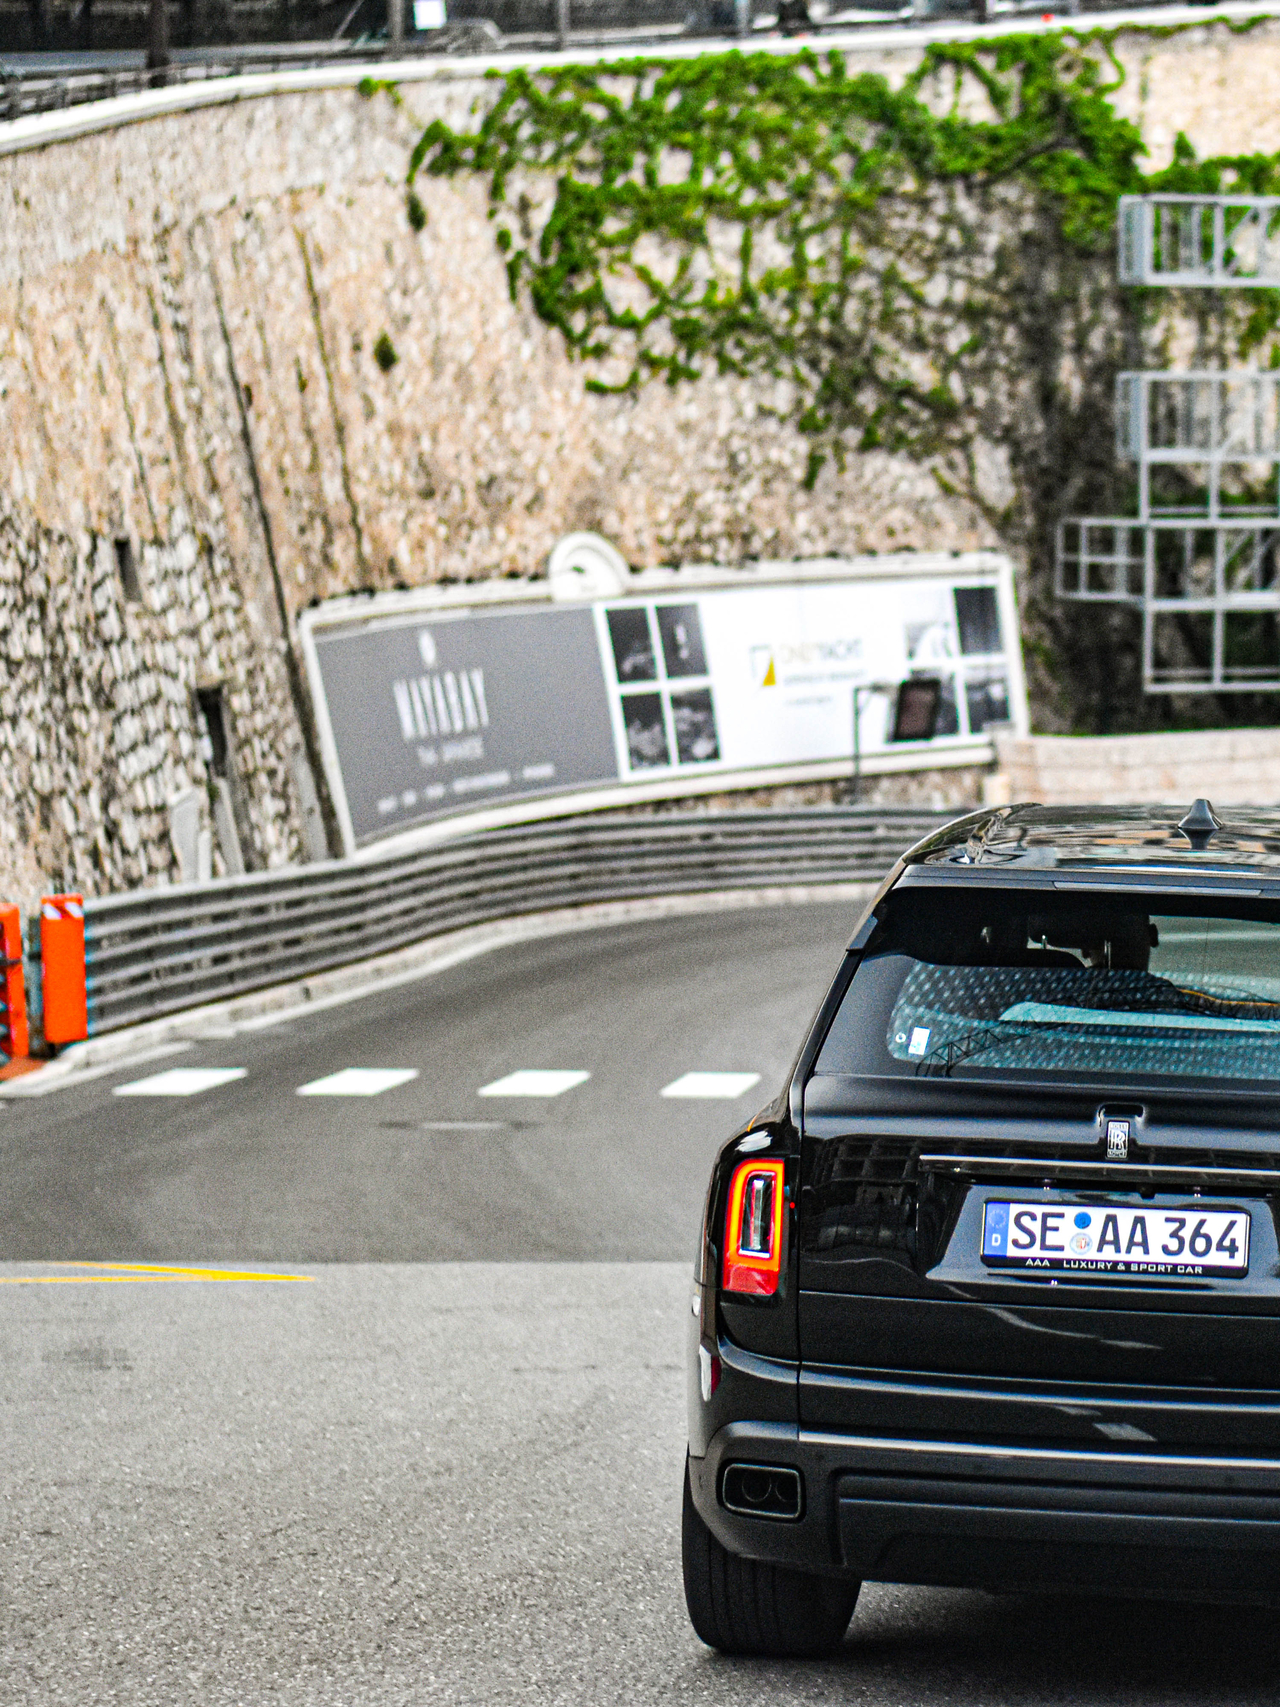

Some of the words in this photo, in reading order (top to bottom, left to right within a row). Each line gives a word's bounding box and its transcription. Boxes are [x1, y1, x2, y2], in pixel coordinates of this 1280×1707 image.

[991, 1233, 1001, 1247] D
[1011, 1210, 1065, 1252] SE
[1096, 1213, 1150, 1256] AA
[1161, 1216, 1239, 1260] 364
[1025, 1258, 1050, 1267] AAA
[1063, 1260, 1113, 1270] LUXURY
[1117, 1262, 1126, 1270] &
[1130, 1263, 1173, 1273] SPORT
[1177, 1265, 1203, 1274] CAR
